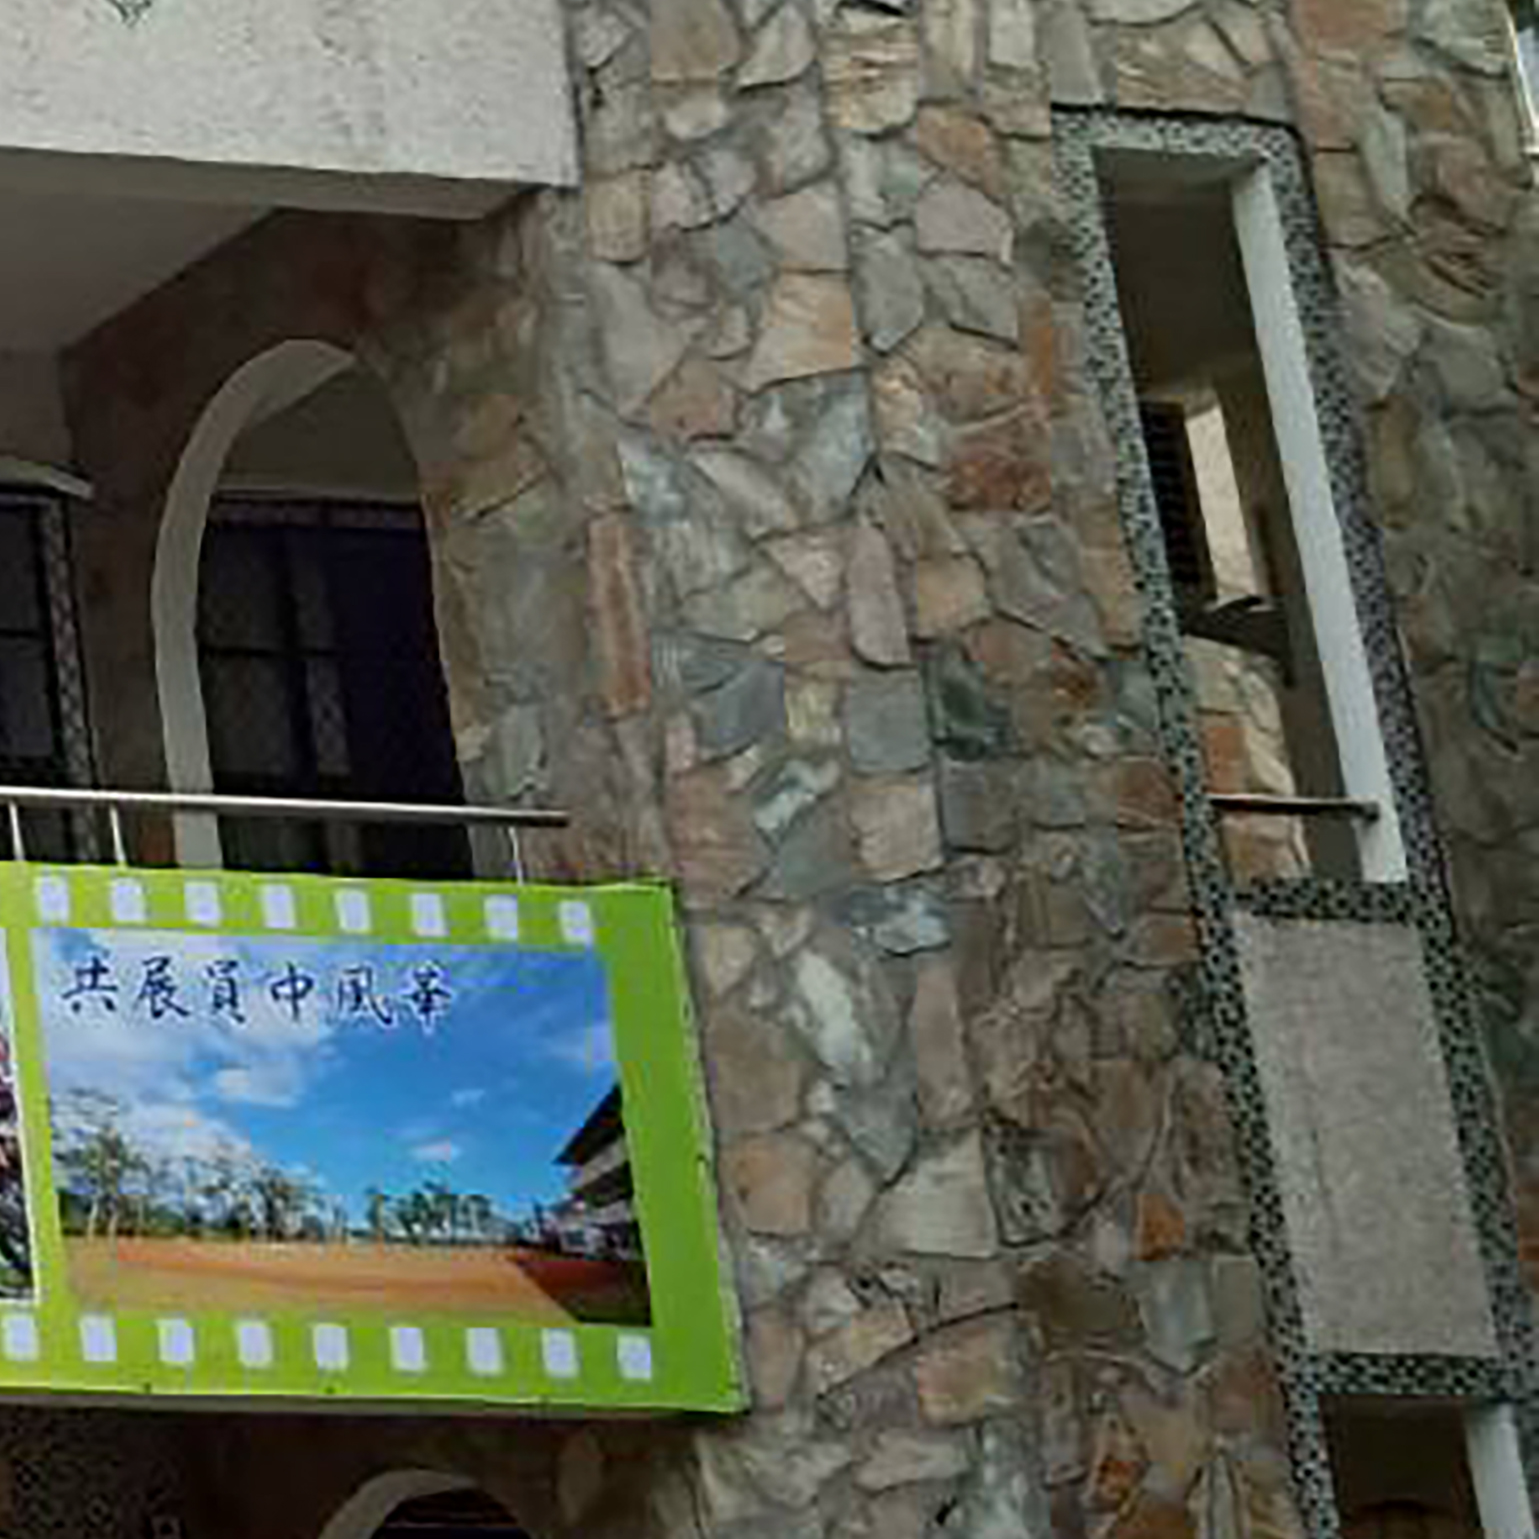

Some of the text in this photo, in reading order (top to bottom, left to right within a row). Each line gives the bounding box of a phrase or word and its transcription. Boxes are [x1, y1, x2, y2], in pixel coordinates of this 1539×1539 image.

[60, 953, 454, 1032] 共展員中風華
